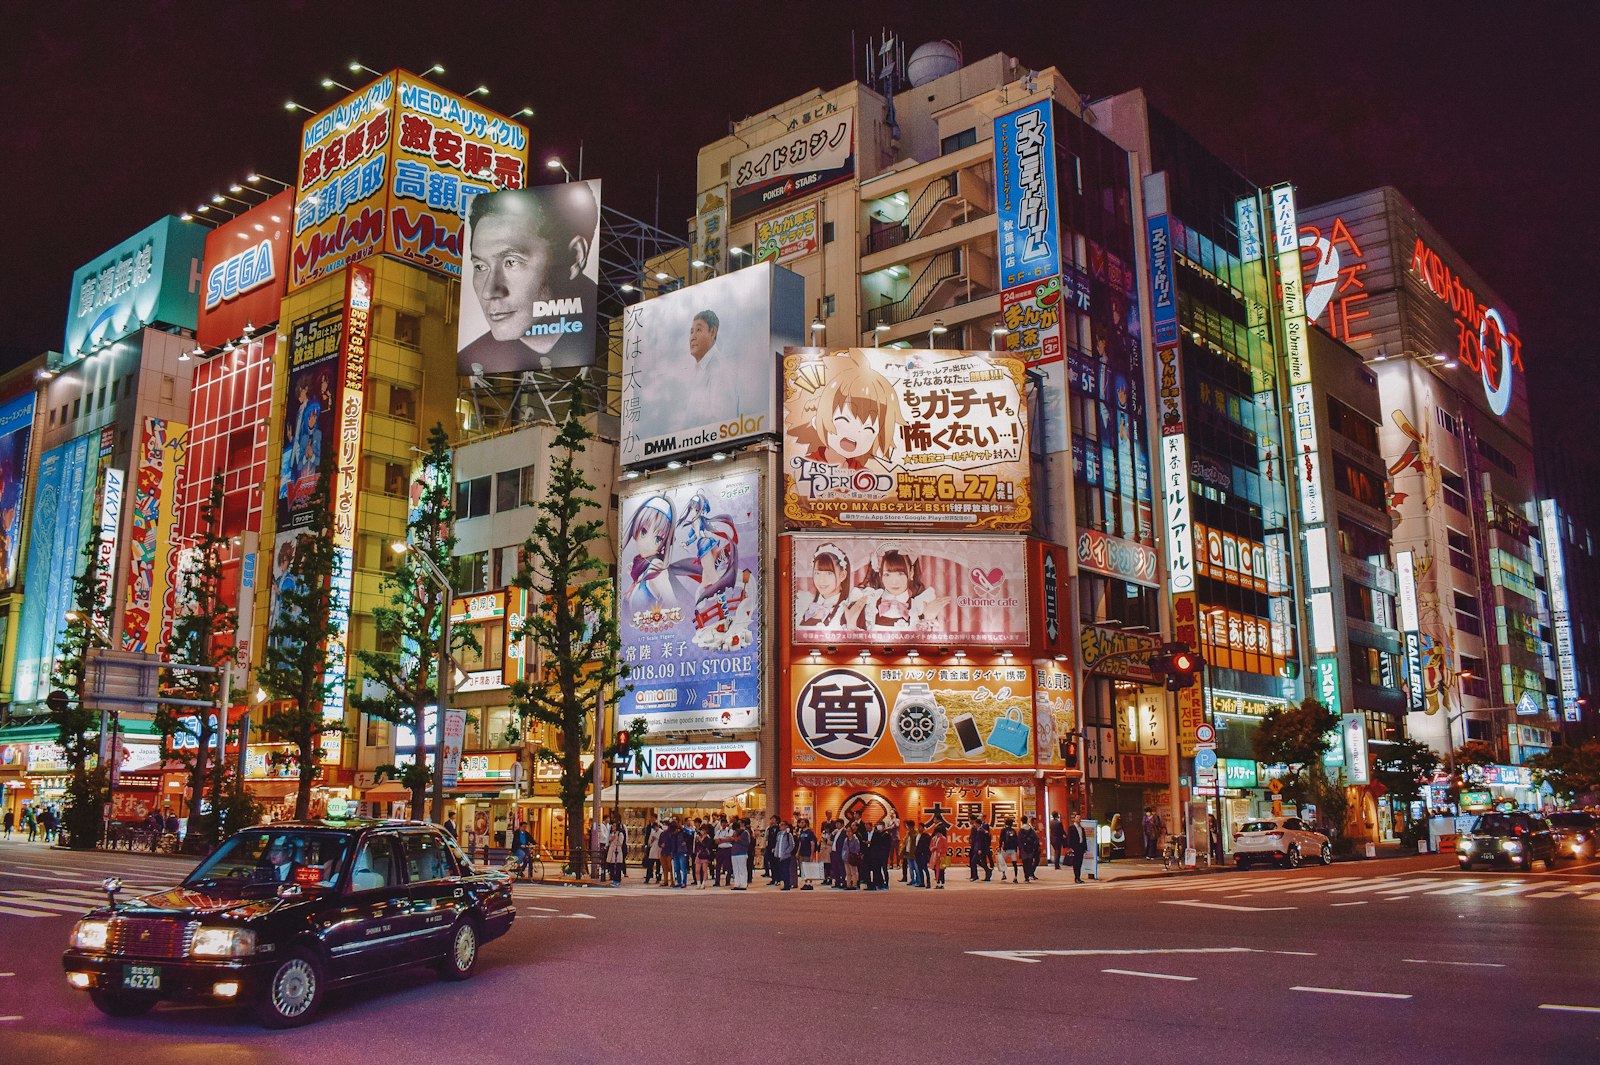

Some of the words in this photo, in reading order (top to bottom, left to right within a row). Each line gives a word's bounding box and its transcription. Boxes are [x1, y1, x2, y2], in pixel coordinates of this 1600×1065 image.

[401, 83, 526, 151] MEDIAリサイクル
[301, 110, 391, 190] 激安販売
[400, 114, 524, 190] 激安販売
[737, 123, 847, 186] メイドカジノ
[296, 155, 386, 236] 高額買取
[763, 186, 784, 202] POKER
[758, 207, 817, 244] まんが喫茶
[1278, 193, 1293, 248] スーパービル
[293, 207, 384, 285] Mulan
[403, 248, 443, 267] ムーラン
[205, 239, 276, 311] SEGA
[532, 297, 583, 318] DMM
[1077, 290, 1091, 311] 7F
[1283, 280, 1297, 314] Yellow
[351, 309, 367, 320] DVD
[525, 317, 583, 336] .make
[1003, 302, 1059, 330] まんが
[351, 335, 363, 346] CD
[1044, 343, 1058, 354] 3F
[1287, 322, 1302, 379] Submarine
[622, 306, 644, 462] 次は太陽か。
[1081, 373, 1096, 394] 6F
[1297, 385, 1307, 394] 5F
[719, 413, 765, 440] solar
[898, 473, 937, 486] Blu-ray
[1086, 459, 1100, 483] 5F
[106, 472, 121, 522] AKKY
[898, 484, 937, 500] 第1巻
[938, 473, 998, 500] 6.27
[809, 502, 849, 511] TOKYO
[1168, 438, 1190, 571] 喫茶室ルノアール
[101, 537, 115, 566] Tax
[1078, 532, 1157, 578] メイドカジノ
[243, 553, 256, 588] SEGA
[957, 598, 995, 607] @home
[996, 598, 1018, 606] cafe
[625, 645, 651, 662] 常陸
[680, 661, 697, 677] IN
[702, 656, 752, 675] STORE
[881, 669, 902, 681] 時計
[938, 669, 969, 681] 貴金属
[973, 669, 1003, 681] ダイヤ
[1006, 669, 1027, 681] 携帯
[1406, 634, 1424, 710] GALLERIA
[635, 687, 677, 703] amiami
[808, 683, 877, 747] 質
[1148, 704, 1159, 747] ルノアール
[656, 754, 704, 770] COMIC
[706, 753, 727, 769] ZIN
[944, 786, 997, 799] チケット
[922, 801, 1020, 831] 大黒屋
[130, 974, 160, 989] 62-20
